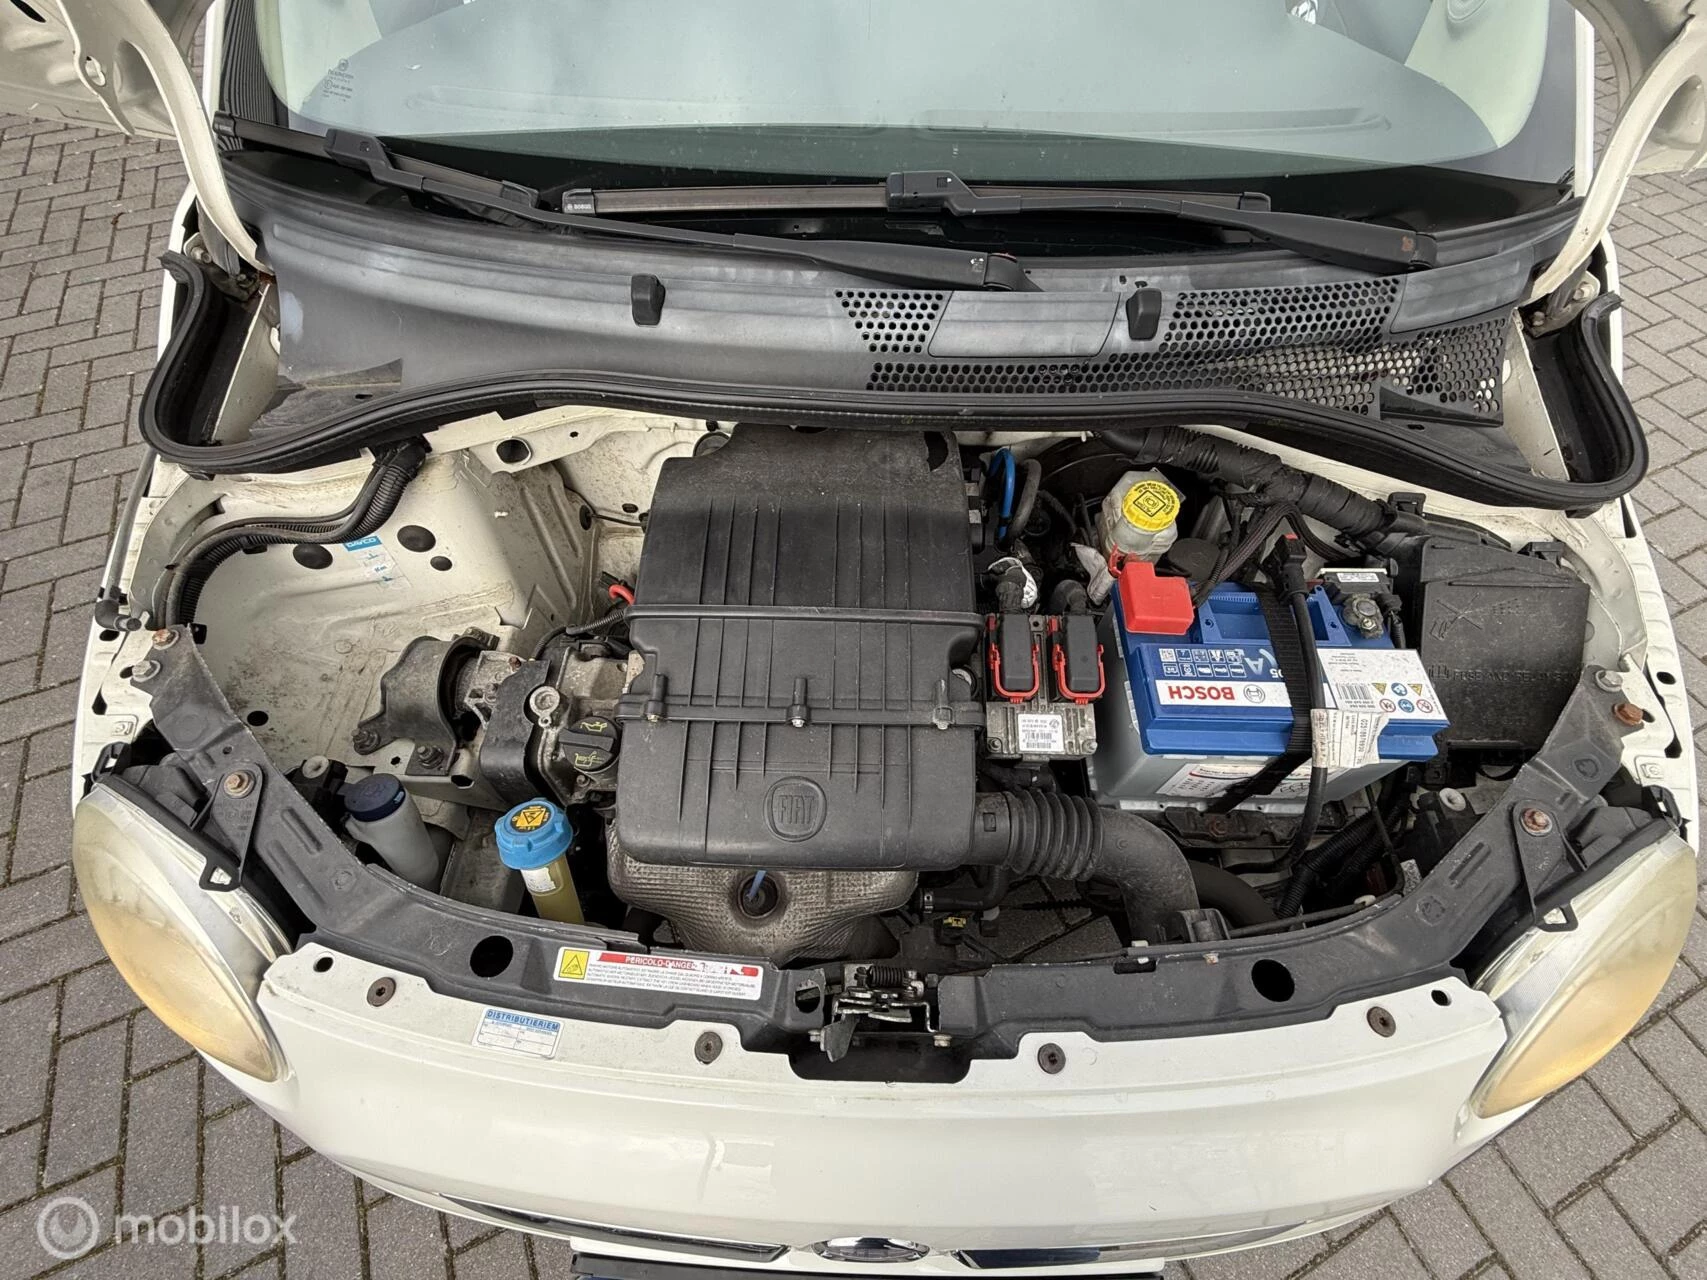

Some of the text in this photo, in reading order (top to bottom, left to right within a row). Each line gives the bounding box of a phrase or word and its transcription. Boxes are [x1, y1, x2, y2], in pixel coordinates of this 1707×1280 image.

[1168, 684, 1236, 702] BOSCH
[778, 794, 815, 824] FIAT
[487, 1010, 559, 1030] DISTRIBUTIERIEM
